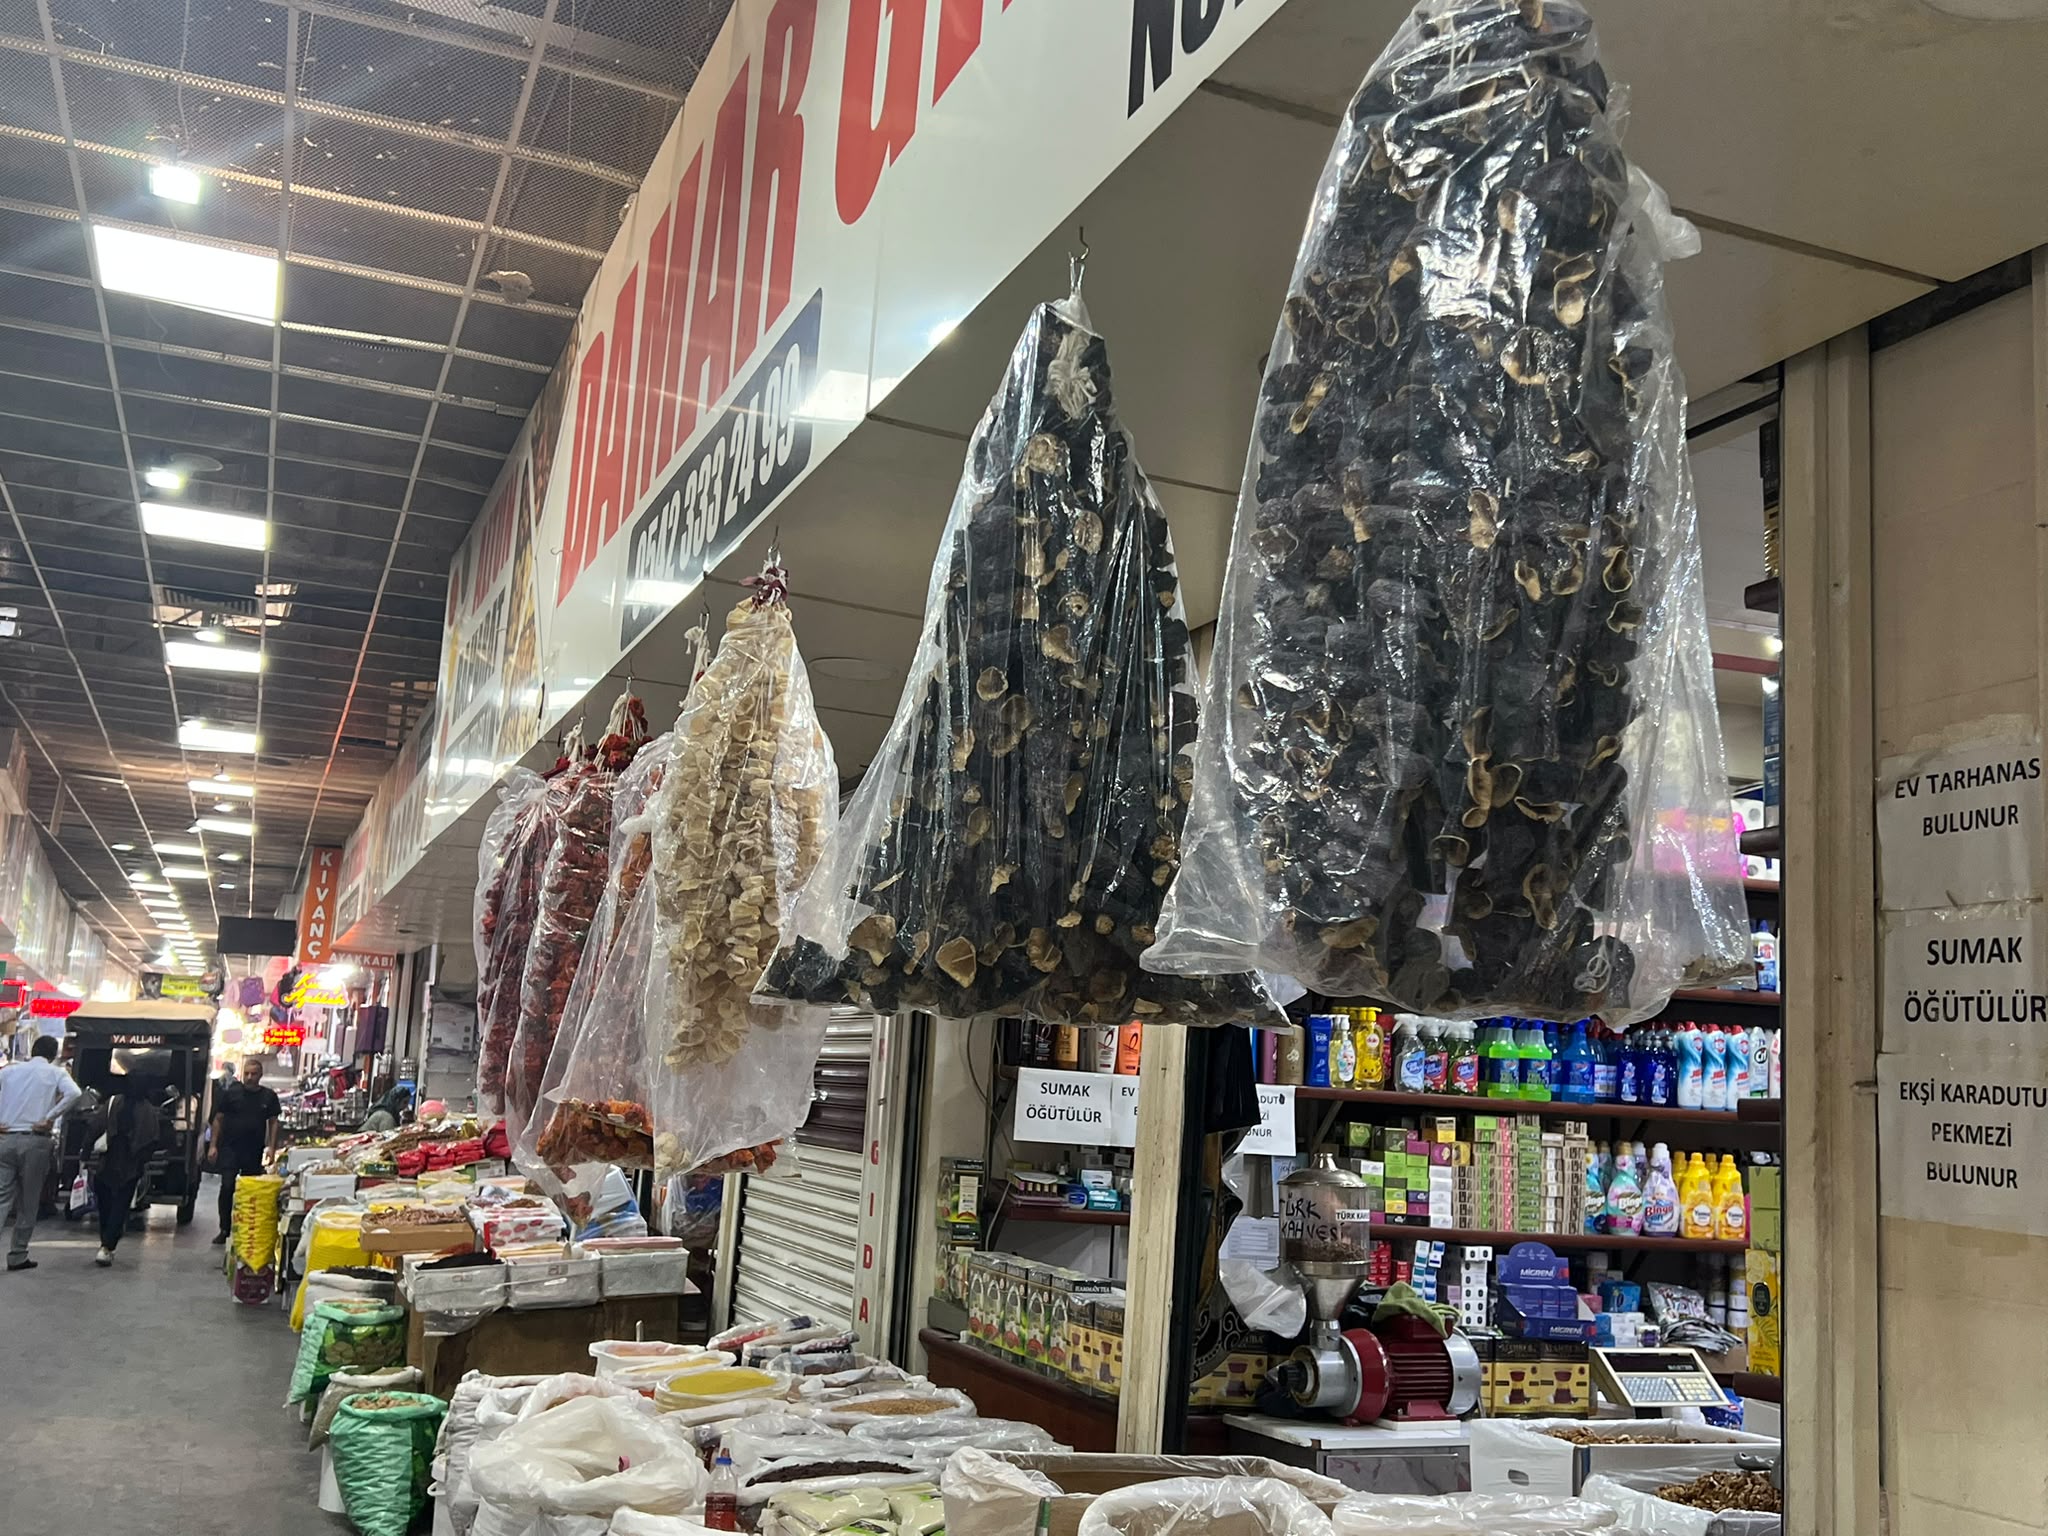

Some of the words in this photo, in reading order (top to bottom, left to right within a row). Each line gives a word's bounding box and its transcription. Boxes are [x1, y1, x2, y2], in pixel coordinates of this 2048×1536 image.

[557, 0, 818, 608] DAMAR
[680, 436, 726, 572] 333
[724, 391, 760, 527] 24
[759, 342, 801, 487] 99
[1895, 777, 1920, 799] EV
[1923, 804, 2019, 837] BULUNUR
[308, 851, 334, 959] KIVANÇ
[329, 951, 394, 968] AYAKKABI
[1927, 936, 2023, 966] SUMAK
[1904, 988, 2048, 1023] ÖĞÜTÜLÜR
[113, 1034, 126, 1044] YA
[130, 1034, 161, 1045] ALLAH
[1756, 1049, 1767, 1062] Cif
[1040, 1082, 1091, 1097] SUMAK
[1121, 1087, 1136, 1097] EV
[1900, 1078, 1935, 1106] EKŞİ
[1941, 1083, 2048, 1108] KARADUTU
[1026, 1104, 1102, 1123] ÖĞÜTÜLÜR
[1931, 1122, 2012, 1147] PEKMEZİ
[1927, 1161, 2018, 1189] BULUNUR
[858, 1140, 879, 1324] GIDA
